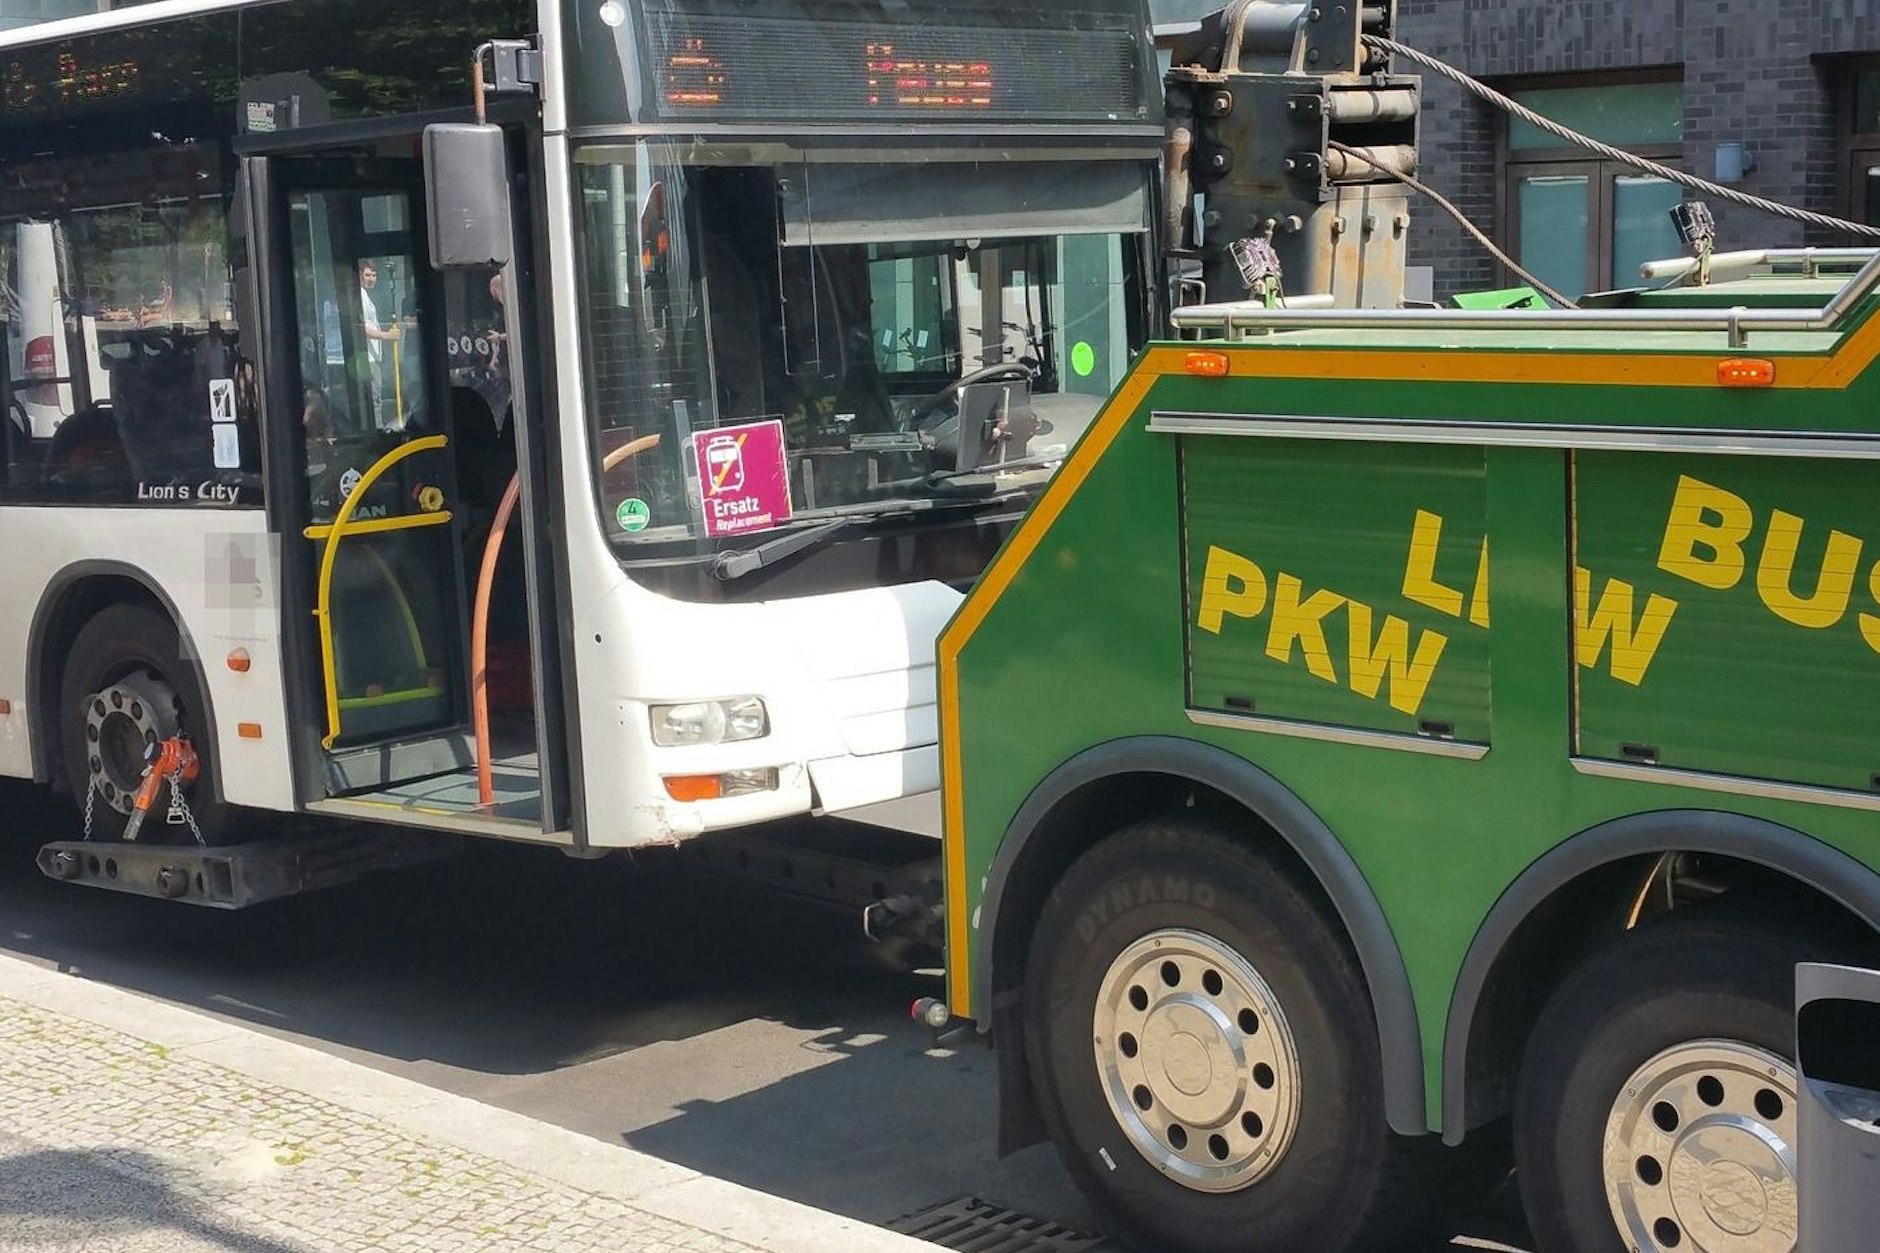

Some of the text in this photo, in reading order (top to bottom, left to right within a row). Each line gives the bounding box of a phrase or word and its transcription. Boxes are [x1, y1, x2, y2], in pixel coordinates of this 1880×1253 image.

[138, 480, 239, 505] Lions City
[714, 496, 760, 517] Ersatz
[717, 512, 772, 531] Replacement
[1401, 509, 1679, 686] LW
[1656, 474, 1880, 656] BU
[1198, 545, 1448, 715] PKW
[1074, 875, 1217, 944] DYNAMO
